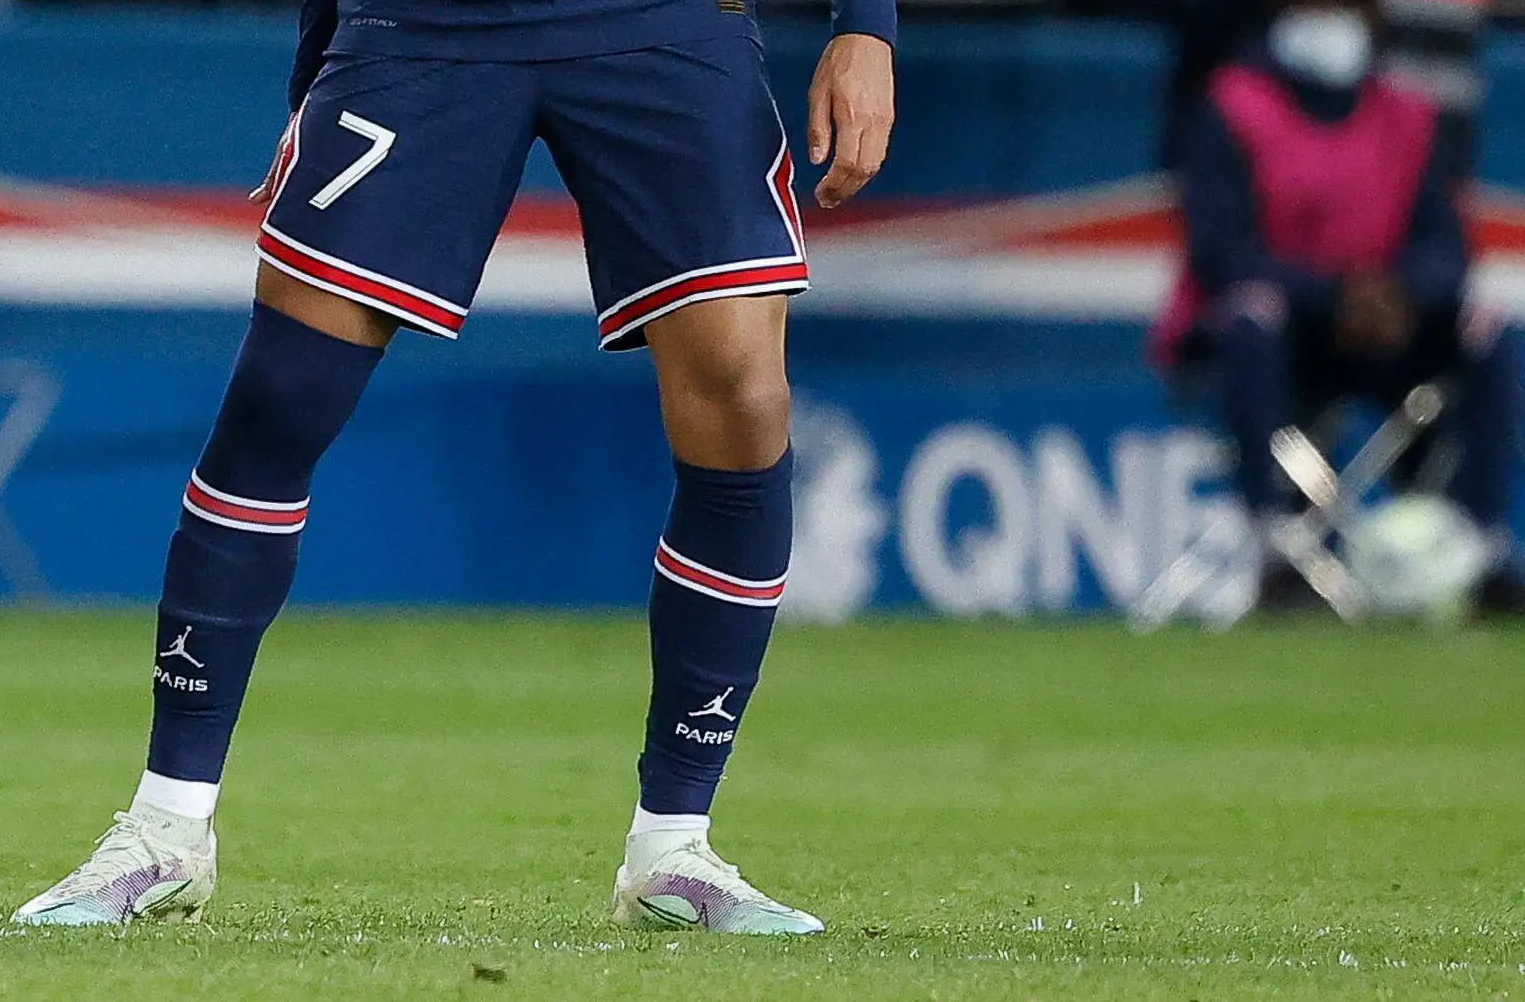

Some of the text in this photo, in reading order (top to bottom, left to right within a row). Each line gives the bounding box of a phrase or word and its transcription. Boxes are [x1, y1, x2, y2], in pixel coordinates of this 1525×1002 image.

[309, 110, 397, 211] 7
[153, 665, 208, 692] PARIS
[675, 722, 734, 745] PARIS
